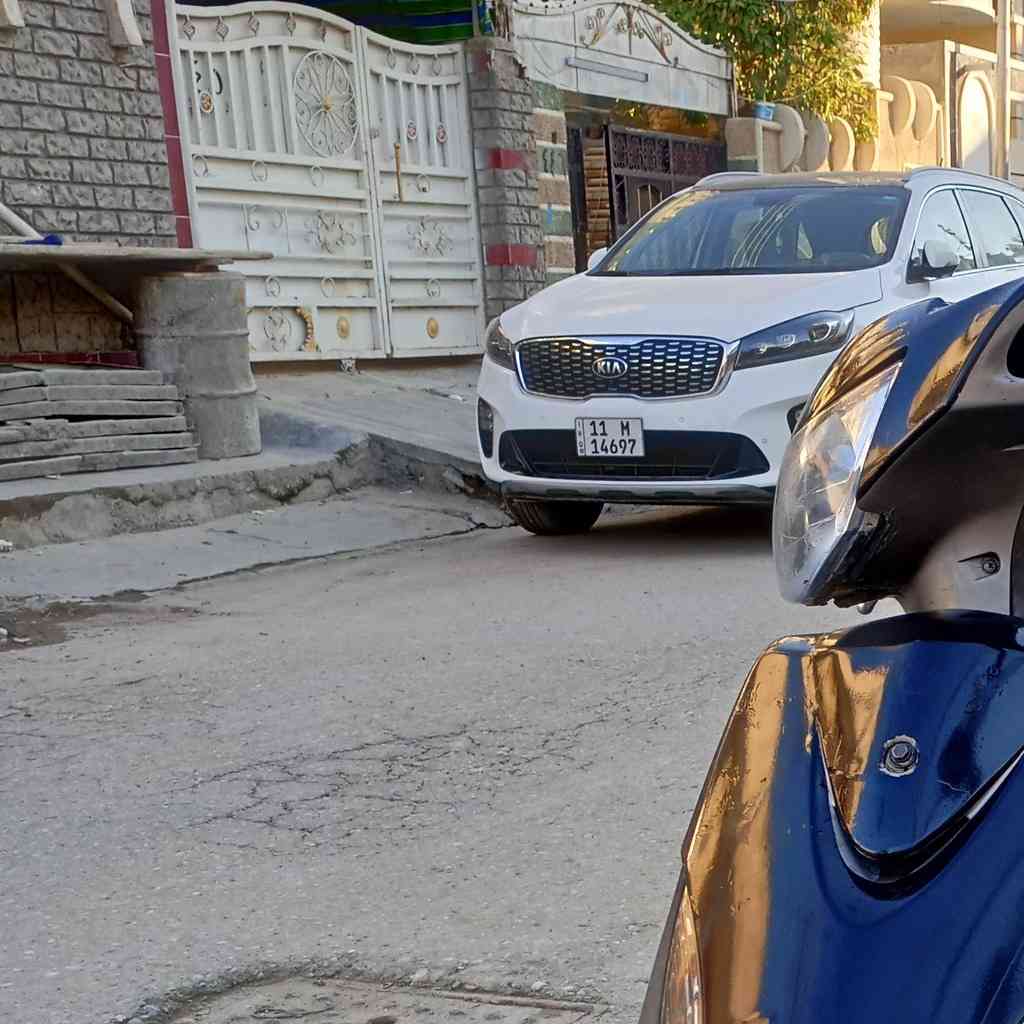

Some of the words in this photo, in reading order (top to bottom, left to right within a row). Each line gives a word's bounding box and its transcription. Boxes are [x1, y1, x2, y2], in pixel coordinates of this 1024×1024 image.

[596, 360, 622, 375] KIA
[590, 420, 608, 436] 11
[620, 420, 630, 436] M
[590, 438, 636, 454] 14697
